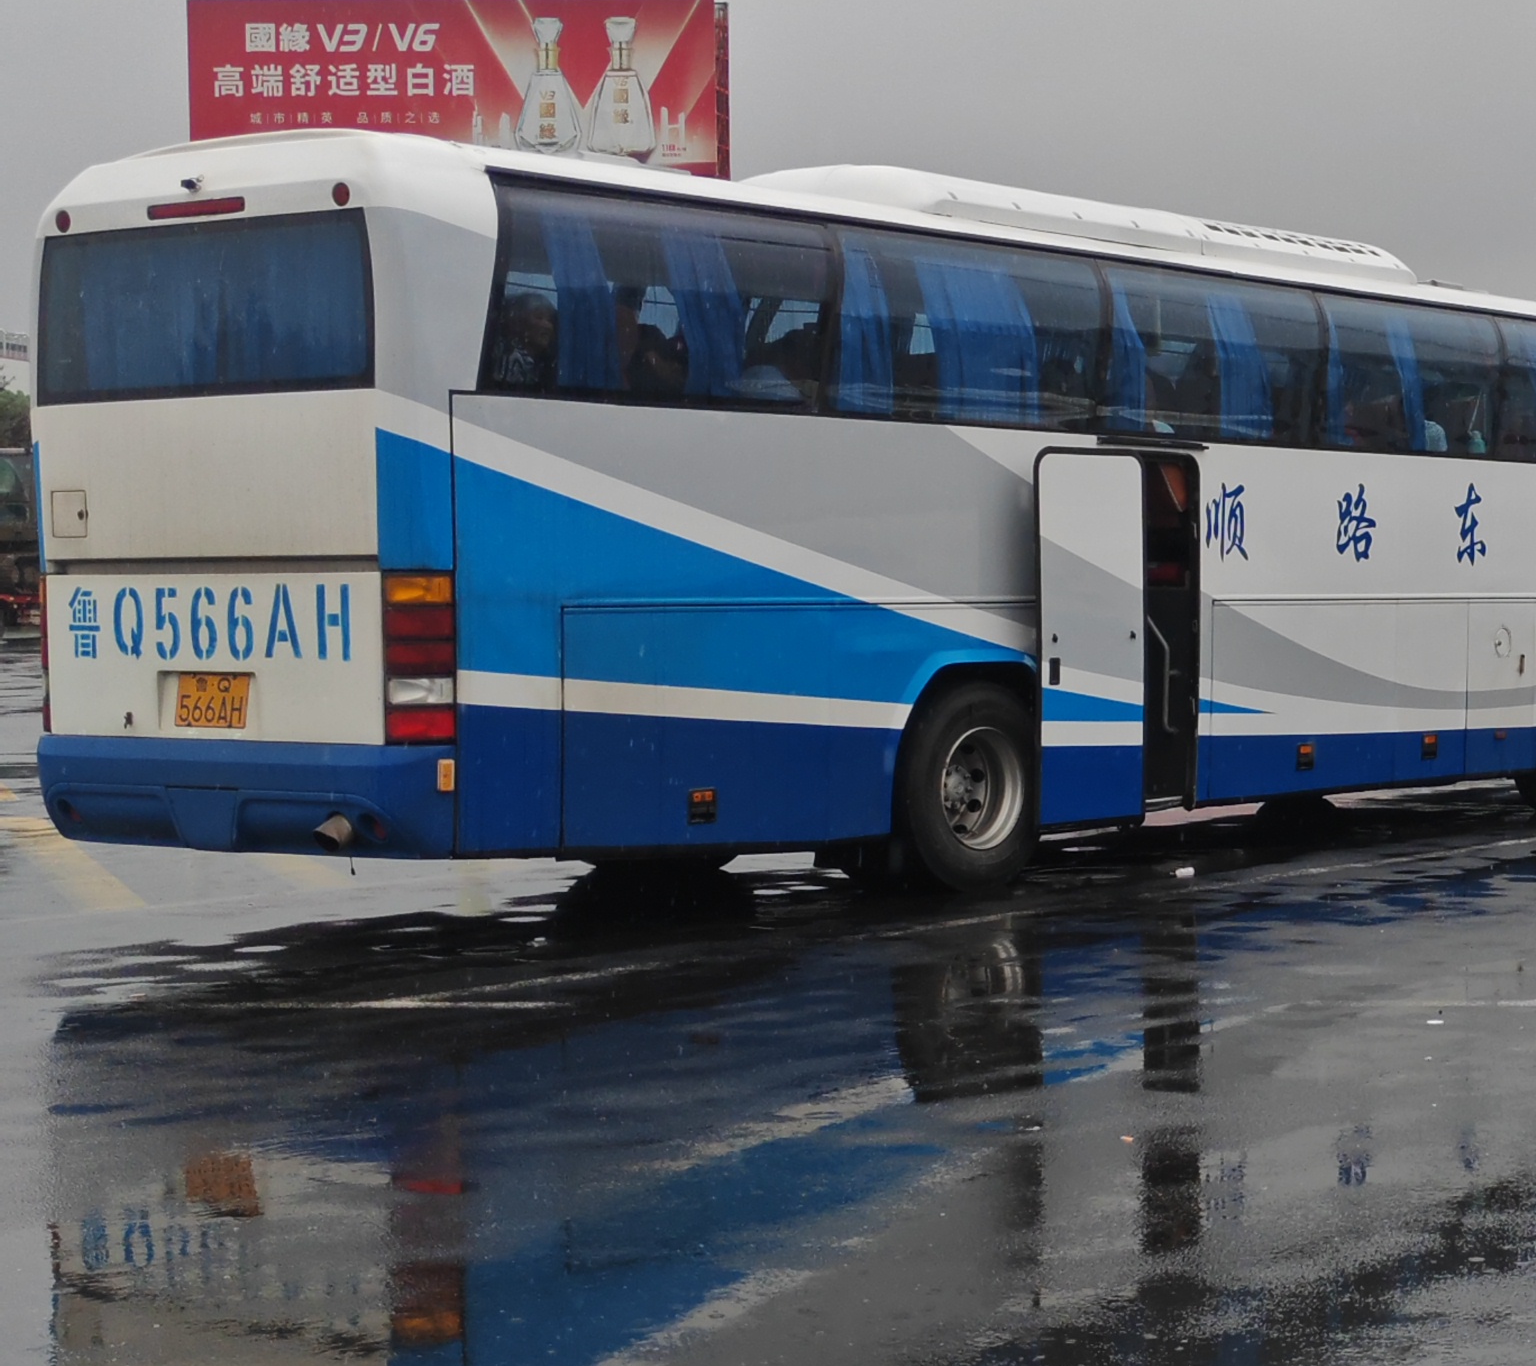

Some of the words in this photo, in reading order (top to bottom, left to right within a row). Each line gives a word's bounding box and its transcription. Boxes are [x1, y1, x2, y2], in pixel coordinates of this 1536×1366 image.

[213, 63, 475, 98] 高端舒适型白酒
[539, 90, 556, 101] V3
[68, 582, 352, 662] 鲁Q566AH
[179, 694, 244, 725] 566AH
